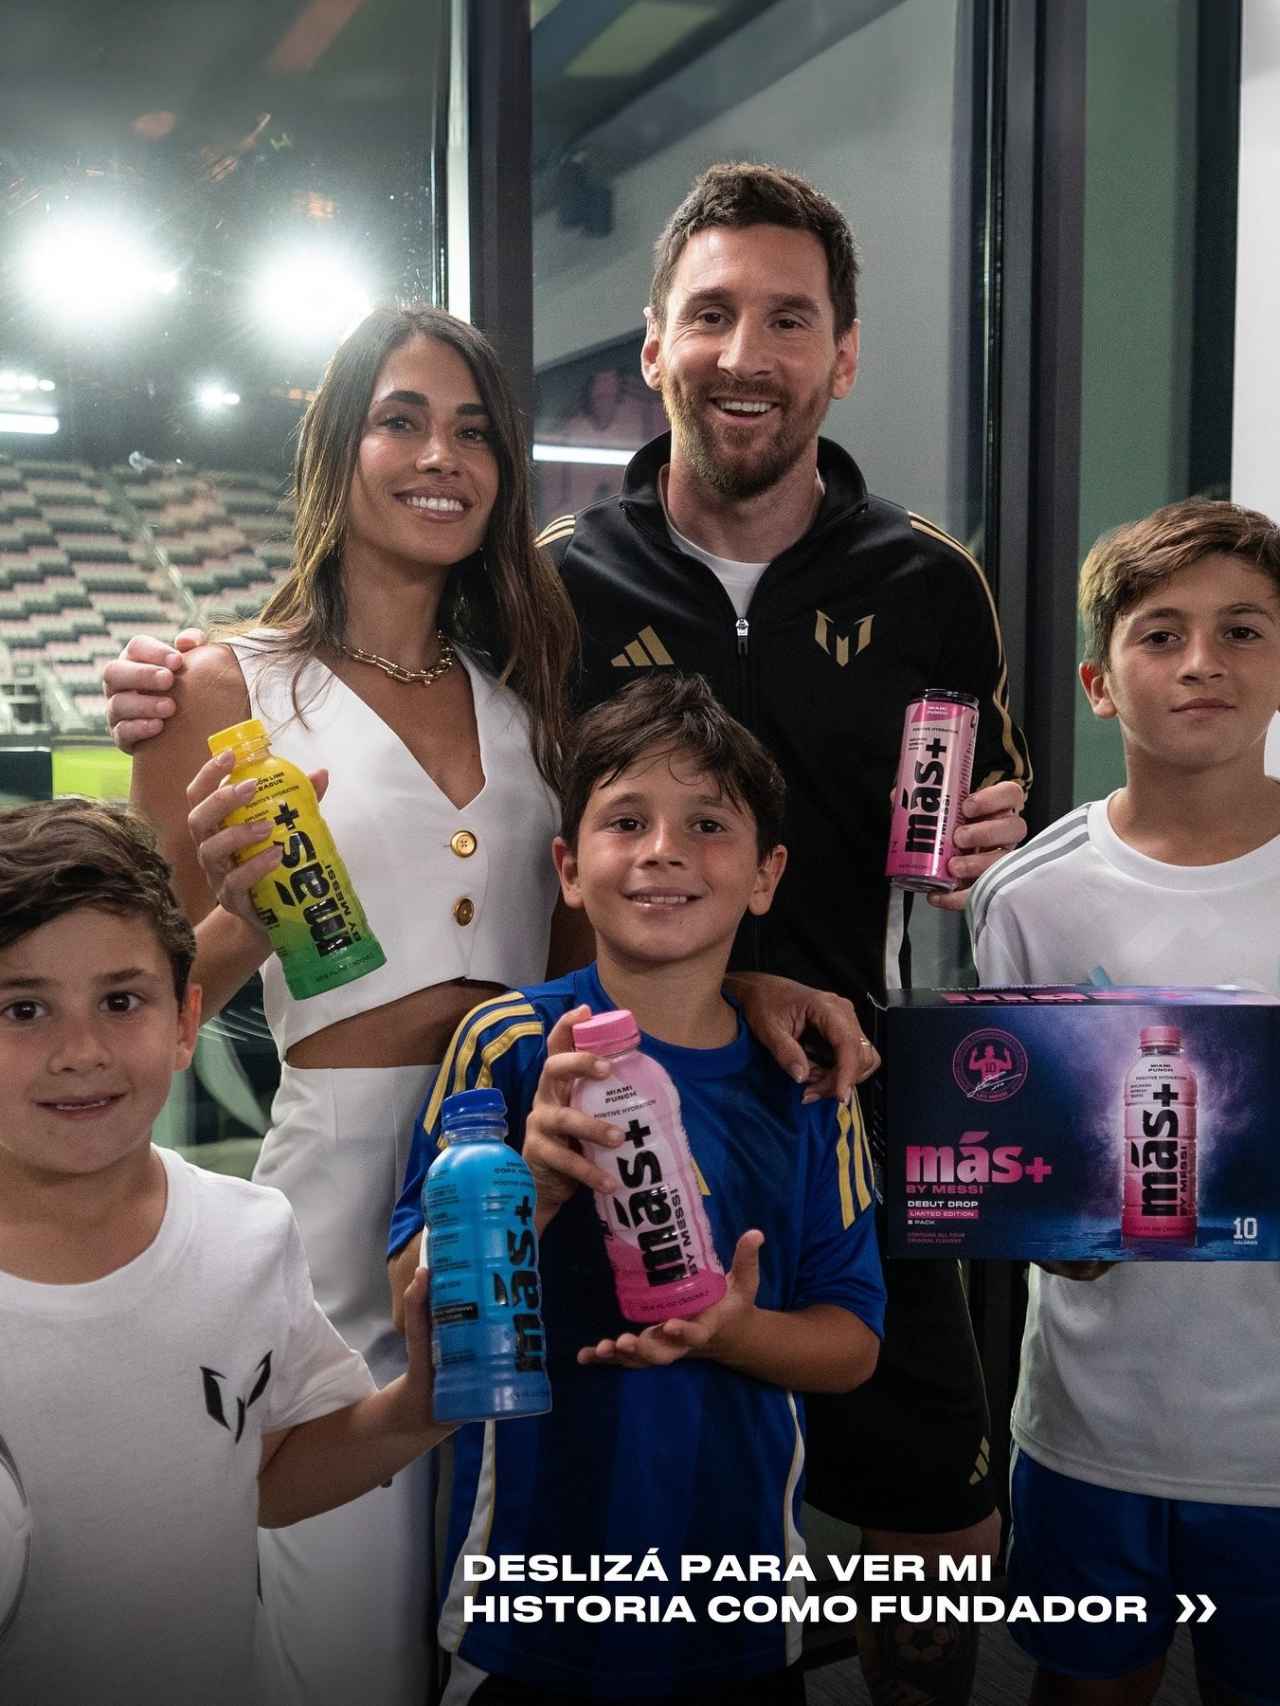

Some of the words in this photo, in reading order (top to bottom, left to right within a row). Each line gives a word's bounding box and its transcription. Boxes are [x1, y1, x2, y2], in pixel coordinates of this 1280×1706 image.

[902, 738, 947, 854] más+
[273, 802, 353, 957] más+
[324, 864, 352, 919] MESSI
[604, 1090, 638, 1104] PUNCH
[606, 1084, 633, 1096] MIAMI
[906, 1131, 1052, 1184] más+
[1131, 1083, 1180, 1217] más+
[1180, 1145, 1188, 1193] MESSI
[613, 1119, 690, 1288] más+
[906, 1184, 928, 1194] BY
[932, 1184, 984, 1194] MESSI
[907, 1200, 944, 1208] DEBUT
[947, 1200, 979, 1208] DROP
[670, 1188, 692, 1247] MESSI
[1233, 1217, 1258, 1239] 10
[493, 1195, 545, 1373] más+
[686, 1253, 698, 1276] BY
